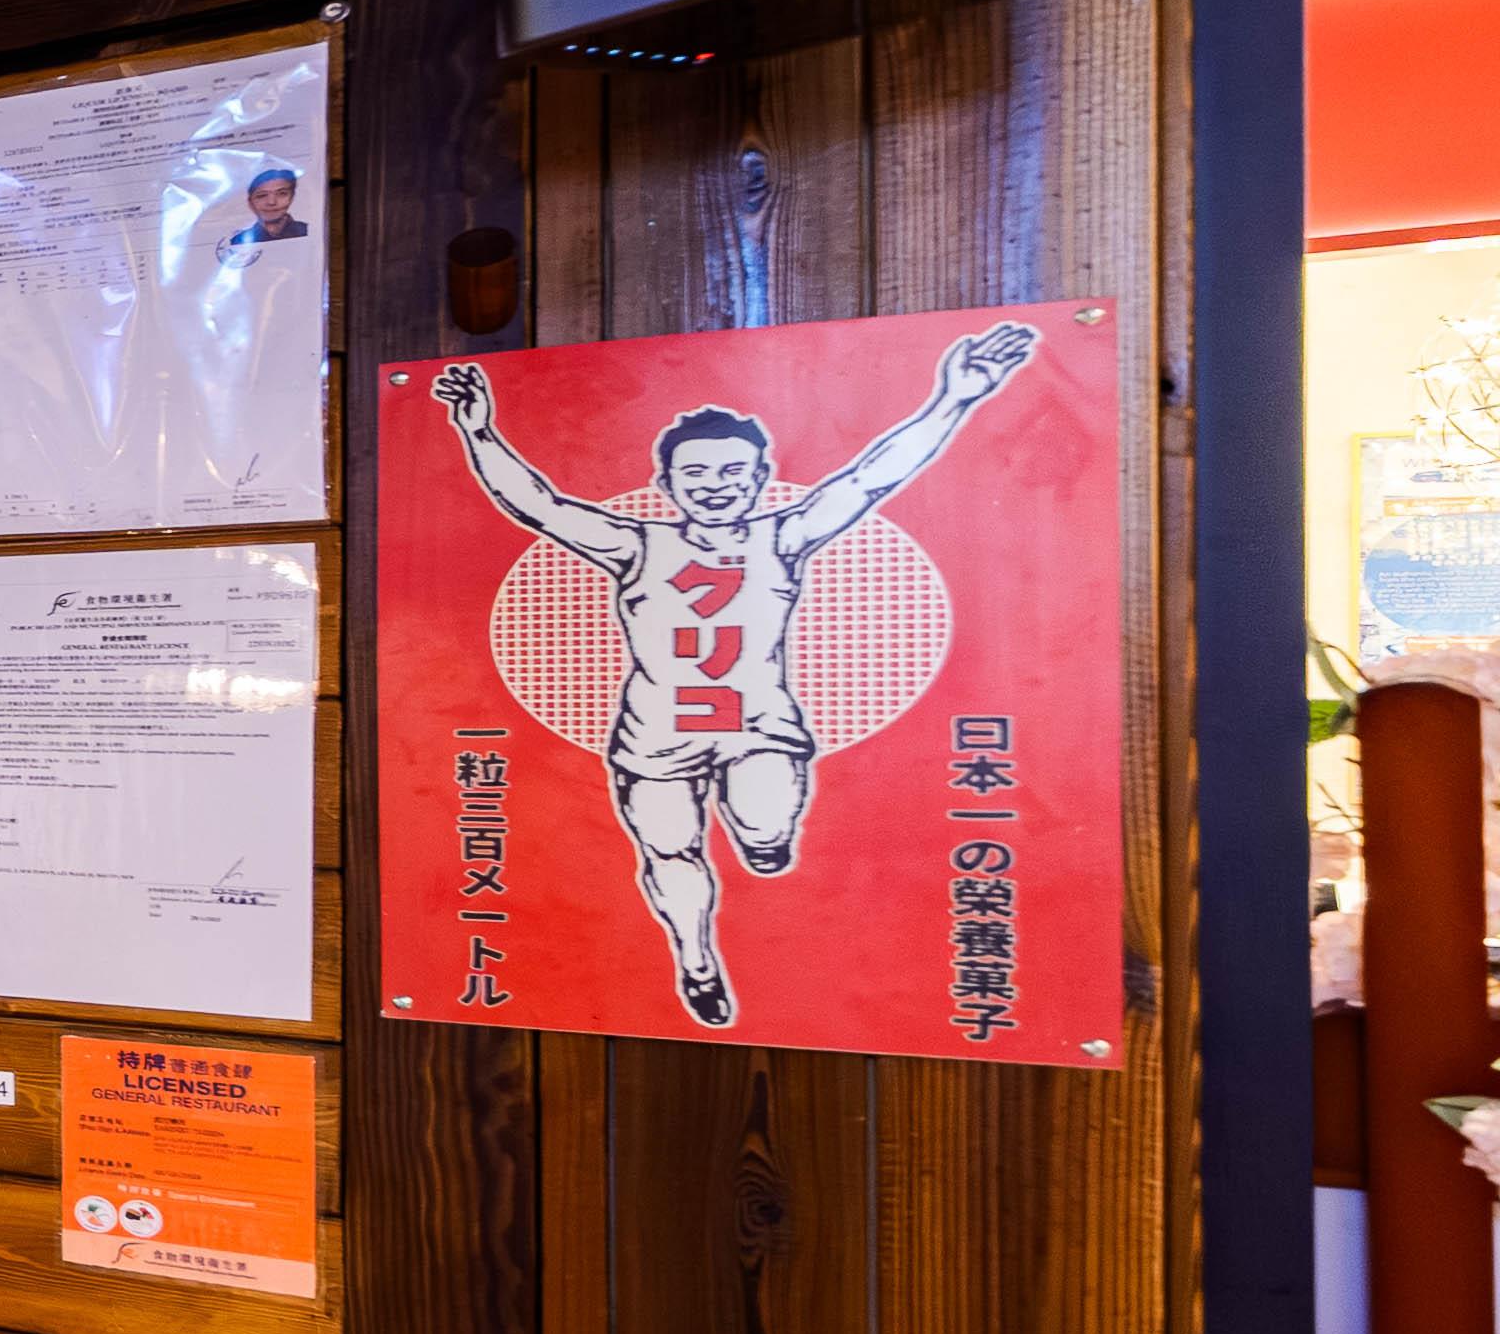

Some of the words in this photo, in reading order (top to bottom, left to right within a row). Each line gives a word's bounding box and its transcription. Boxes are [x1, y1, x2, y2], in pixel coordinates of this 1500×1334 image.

[666, 554, 749, 734] グリコ
[452, 725, 512, 1010] 一粒三百メートル
[92, 1087, 166, 1108] GENERAL
[171, 1095, 281, 1118] RESTAURANT
[123, 1072, 247, 1099] LICENSED
